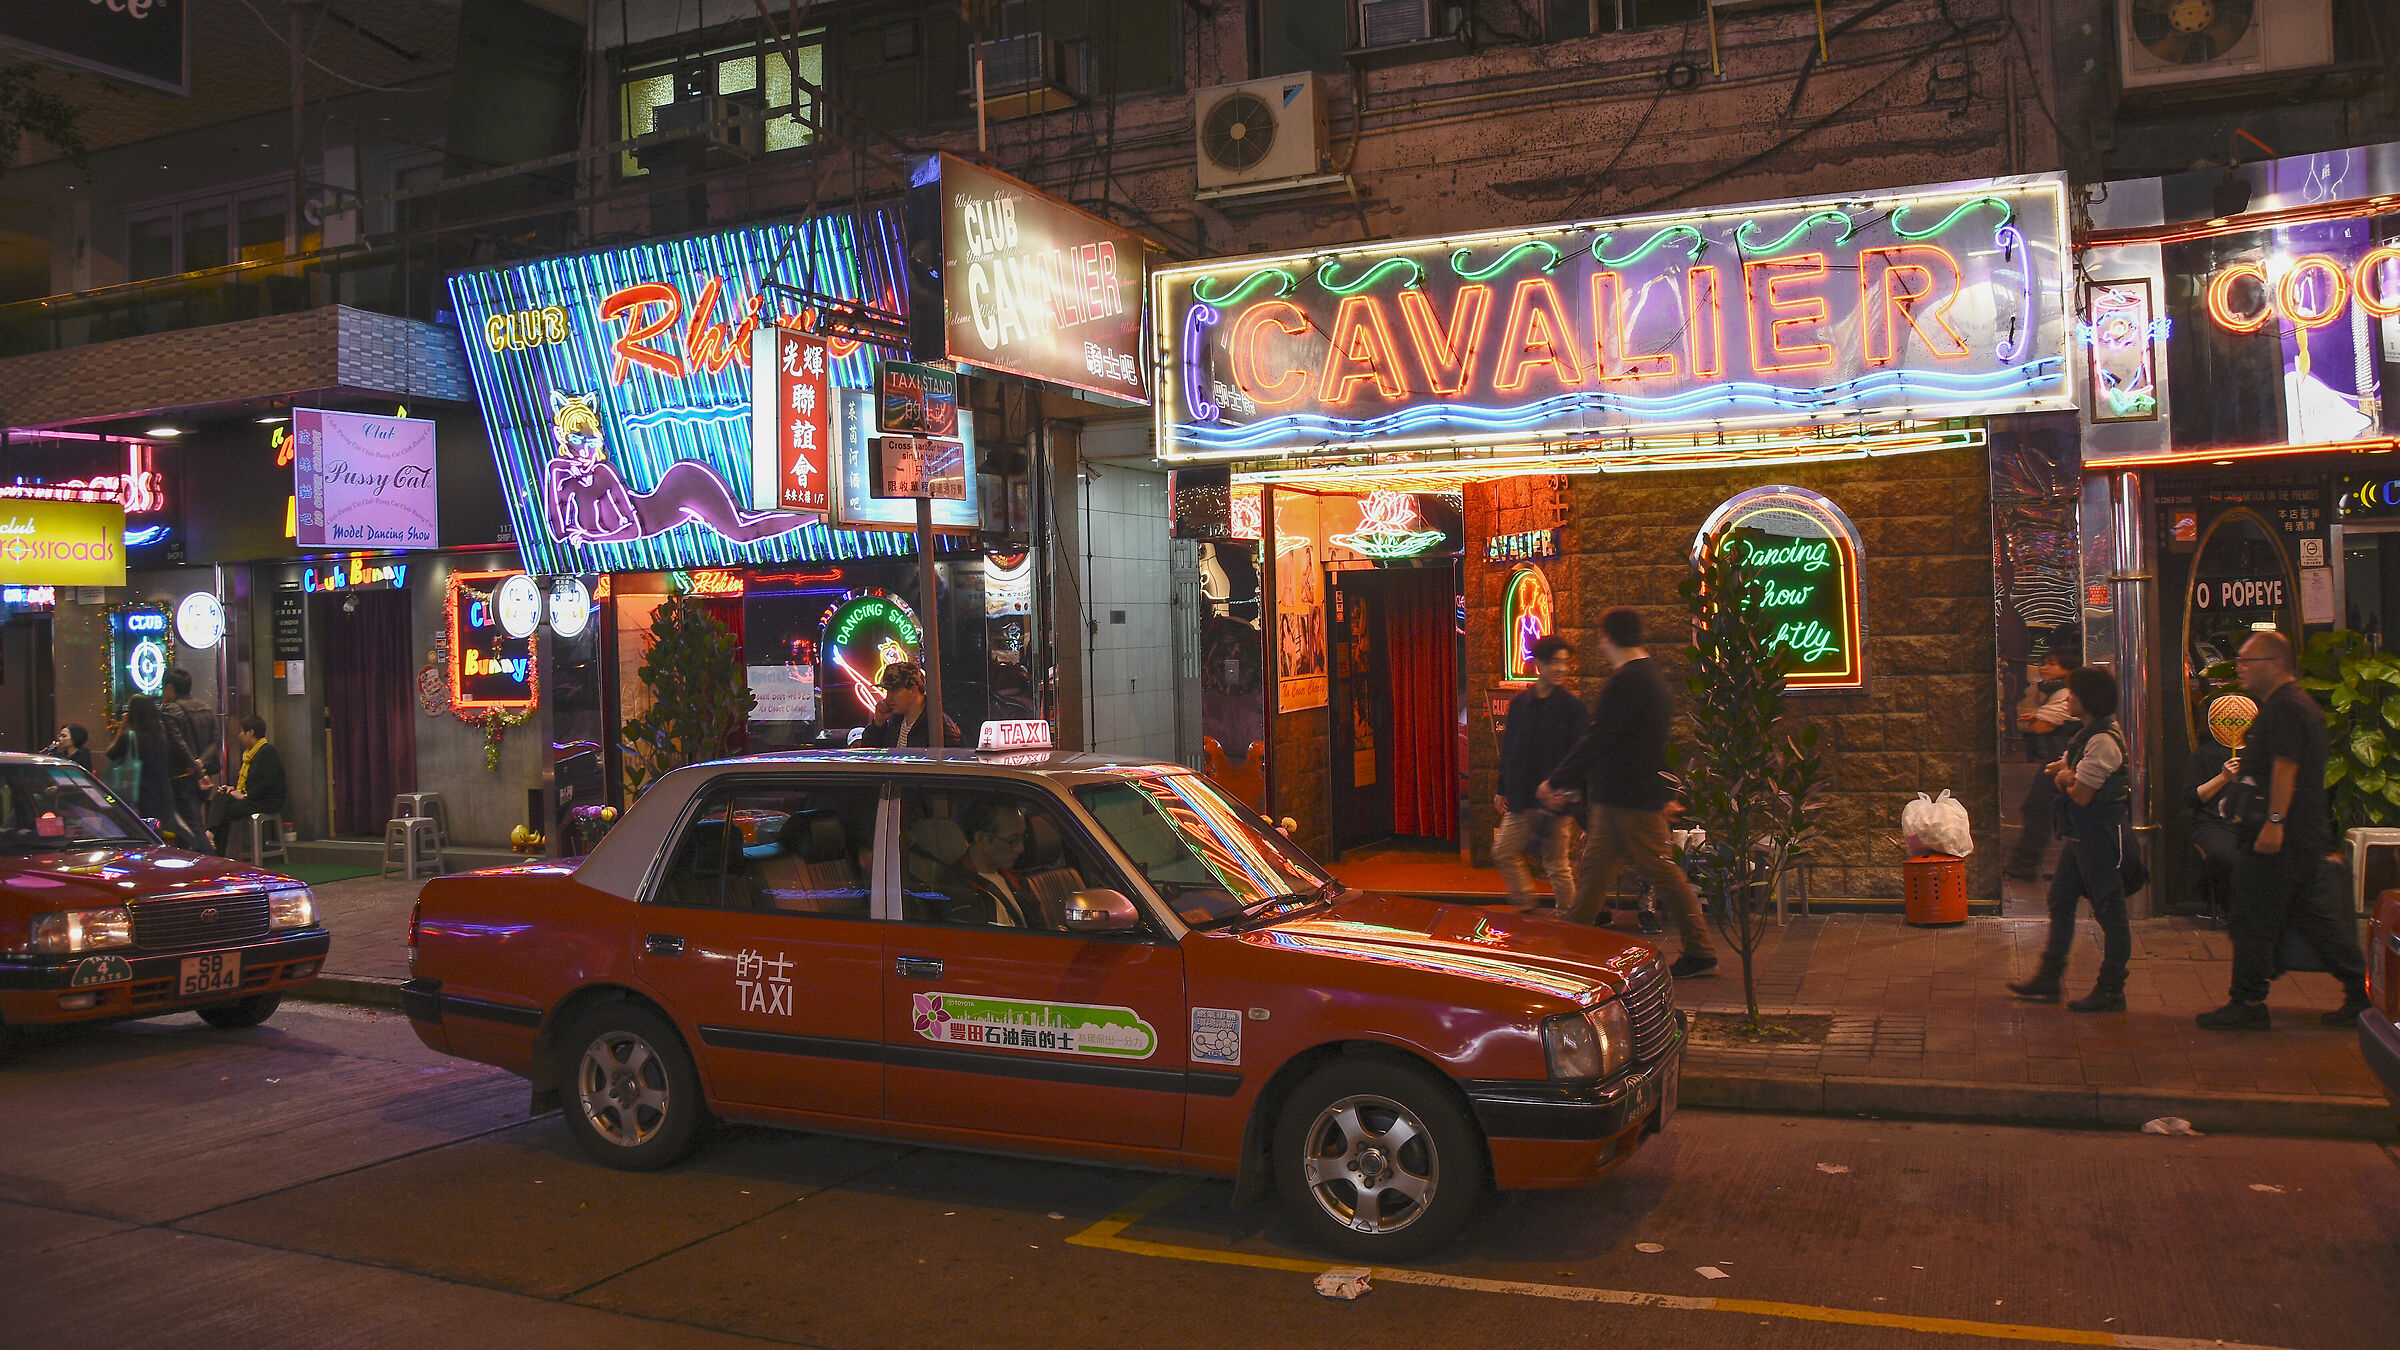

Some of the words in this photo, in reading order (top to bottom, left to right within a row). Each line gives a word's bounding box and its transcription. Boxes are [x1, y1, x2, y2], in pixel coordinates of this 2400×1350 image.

[964, 198, 1018, 257] CLUB
[968, 241, 1123, 350] CAVALIER
[485, 305, 569, 353] CLUB
[1230, 243, 1970, 407] CAVALIER
[890, 371, 921, 390] TAXI
[921, 375, 953, 395] STAND
[362, 422, 395, 440] Club
[324, 459, 389, 496] Pussy
[393, 465, 433, 489] Cat
[0, 517, 36, 534] club
[332, 523, 364, 540] Model
[366, 524, 404, 542] Dancing
[407, 525, 430, 541] Show
[500, 524, 512, 533] 117
[349, 558, 407, 589] Bunny
[2196, 582, 2211, 609] O
[2221, 580, 2283, 607] POPEYE
[128, 614, 163, 631] CLUB
[836, 603, 884, 645] DANCING
[888, 609, 918, 645] SHOW
[464, 649, 528, 683] Bunny
[983, 727, 993, 746] 的士
[1000, 722, 1048, 745] TAXI
[97, 961, 109, 974] 4
[199, 955, 223, 974] SB
[736, 948, 794, 983] 的士
[83, 972, 122, 984] SEATS
[185, 970, 234, 993] 5044
[735, 980, 793, 1016] TAXI
[950, 1022, 1074, 1051] 豐田石油氣的士
